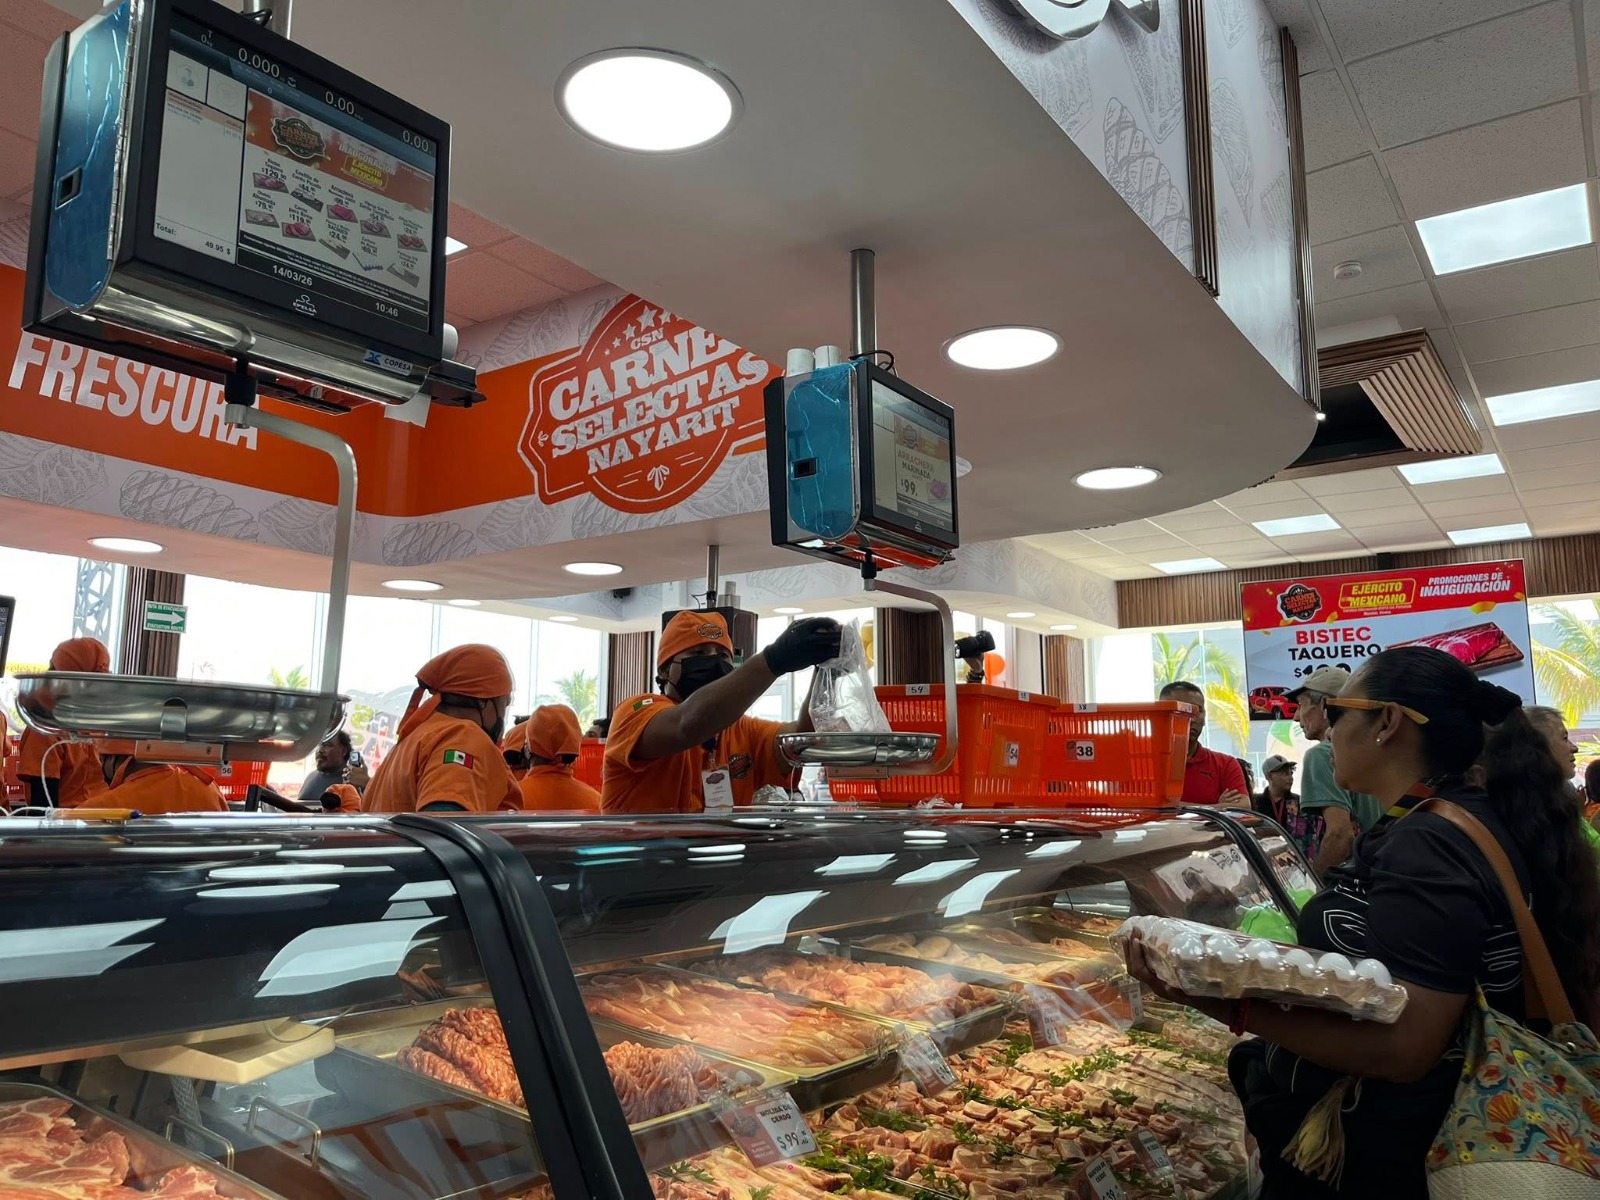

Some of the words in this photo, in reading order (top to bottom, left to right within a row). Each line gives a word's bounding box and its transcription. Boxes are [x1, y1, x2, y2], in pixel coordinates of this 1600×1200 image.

[238, 48, 279, 77] 0.000
[325, 91, 355, 115] 0.00
[402, 130, 429, 152] 0.00
[155, 222, 176, 236] Total:
[205, 241, 224, 253] 49.95
[272, 264, 313, 287] 14/03/26
[375, 302, 399, 318] 10:46
[630, 327, 664, 350] CSN
[384, 357, 411, 372] COPESA
[549, 325, 742, 421] CARNE
[551, 351, 769, 459] SELECTAS
[586, 396, 740, 475] NAYARIT
[1420, 577, 1511, 597] INAUGURACIÓN
[1428, 573, 1489, 585] PROMOCIONES
[1491, 572, 1503, 580] DE
[1351, 581, 1403, 595] EJÉRCITO
[1350, 593, 1407, 607] MEXICANO
[1295, 626, 1372, 645] BISTEC
[1288, 643, 1382, 661] TAQUERO
[1076, 746, 1094, 757] 38
[760, 1105, 783, 1117] MOLIDA
[770, 1113, 791, 1123] CERDO
